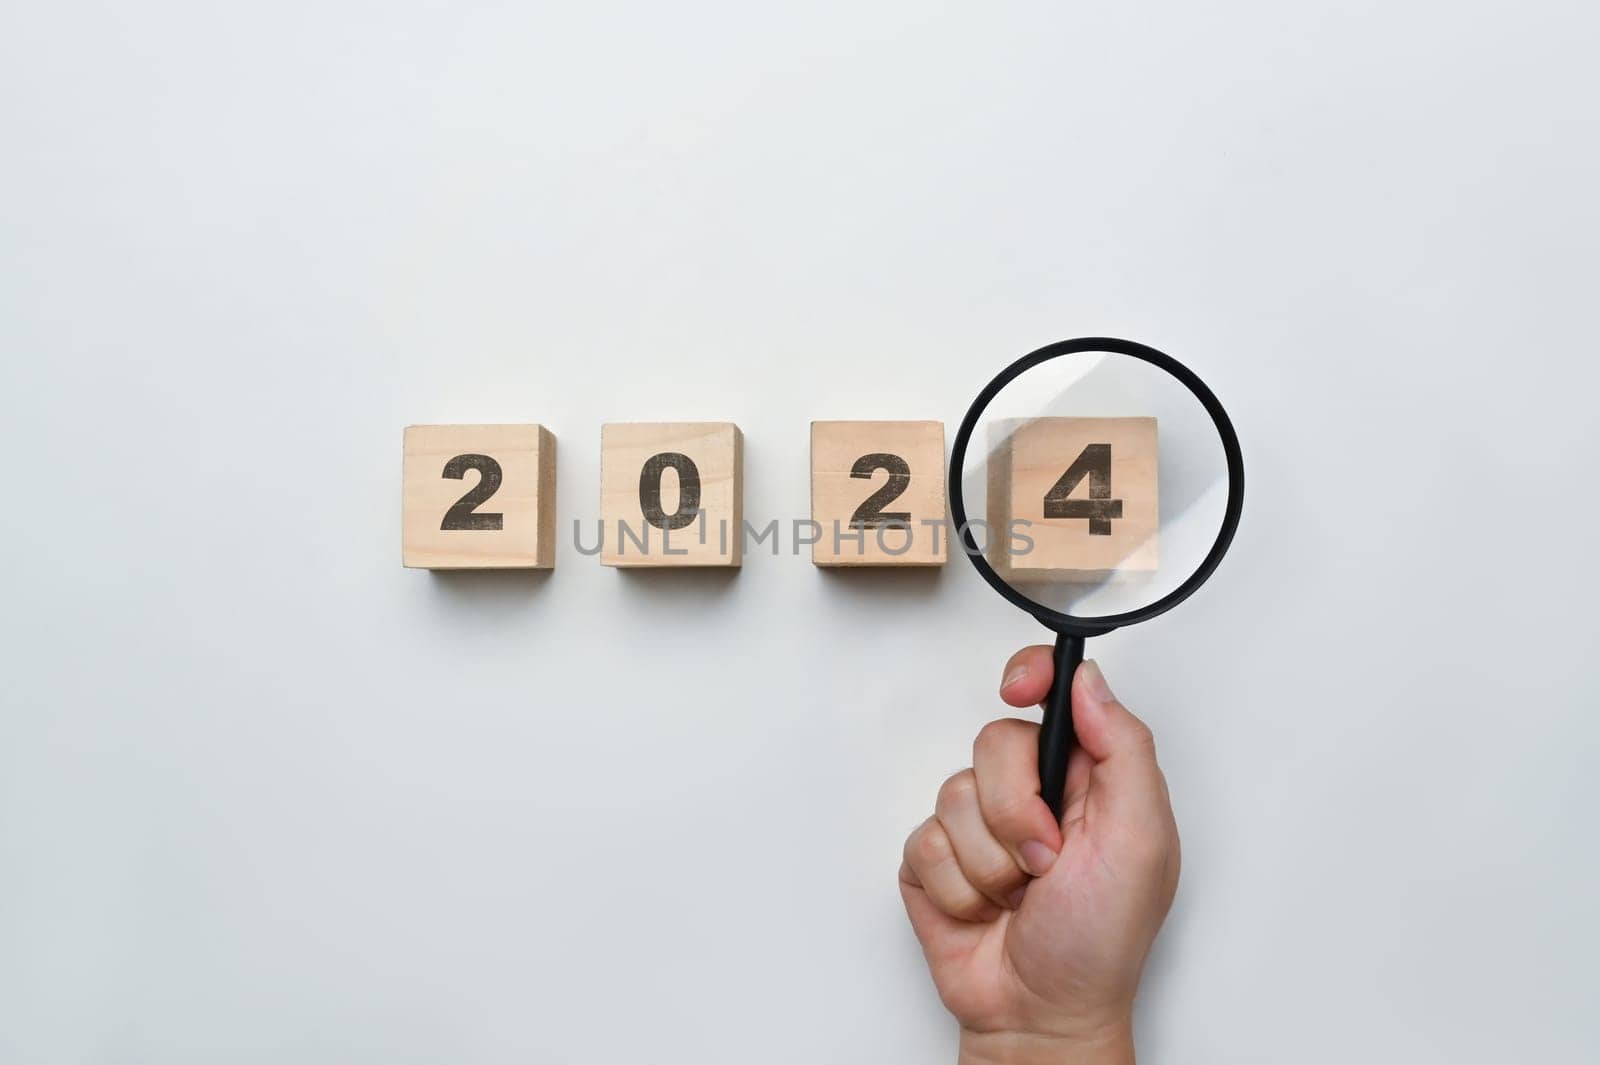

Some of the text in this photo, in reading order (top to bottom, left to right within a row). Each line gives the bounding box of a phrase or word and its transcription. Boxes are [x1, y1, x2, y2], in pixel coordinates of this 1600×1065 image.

[440, 443, 1123, 536] 2 0 2 4
